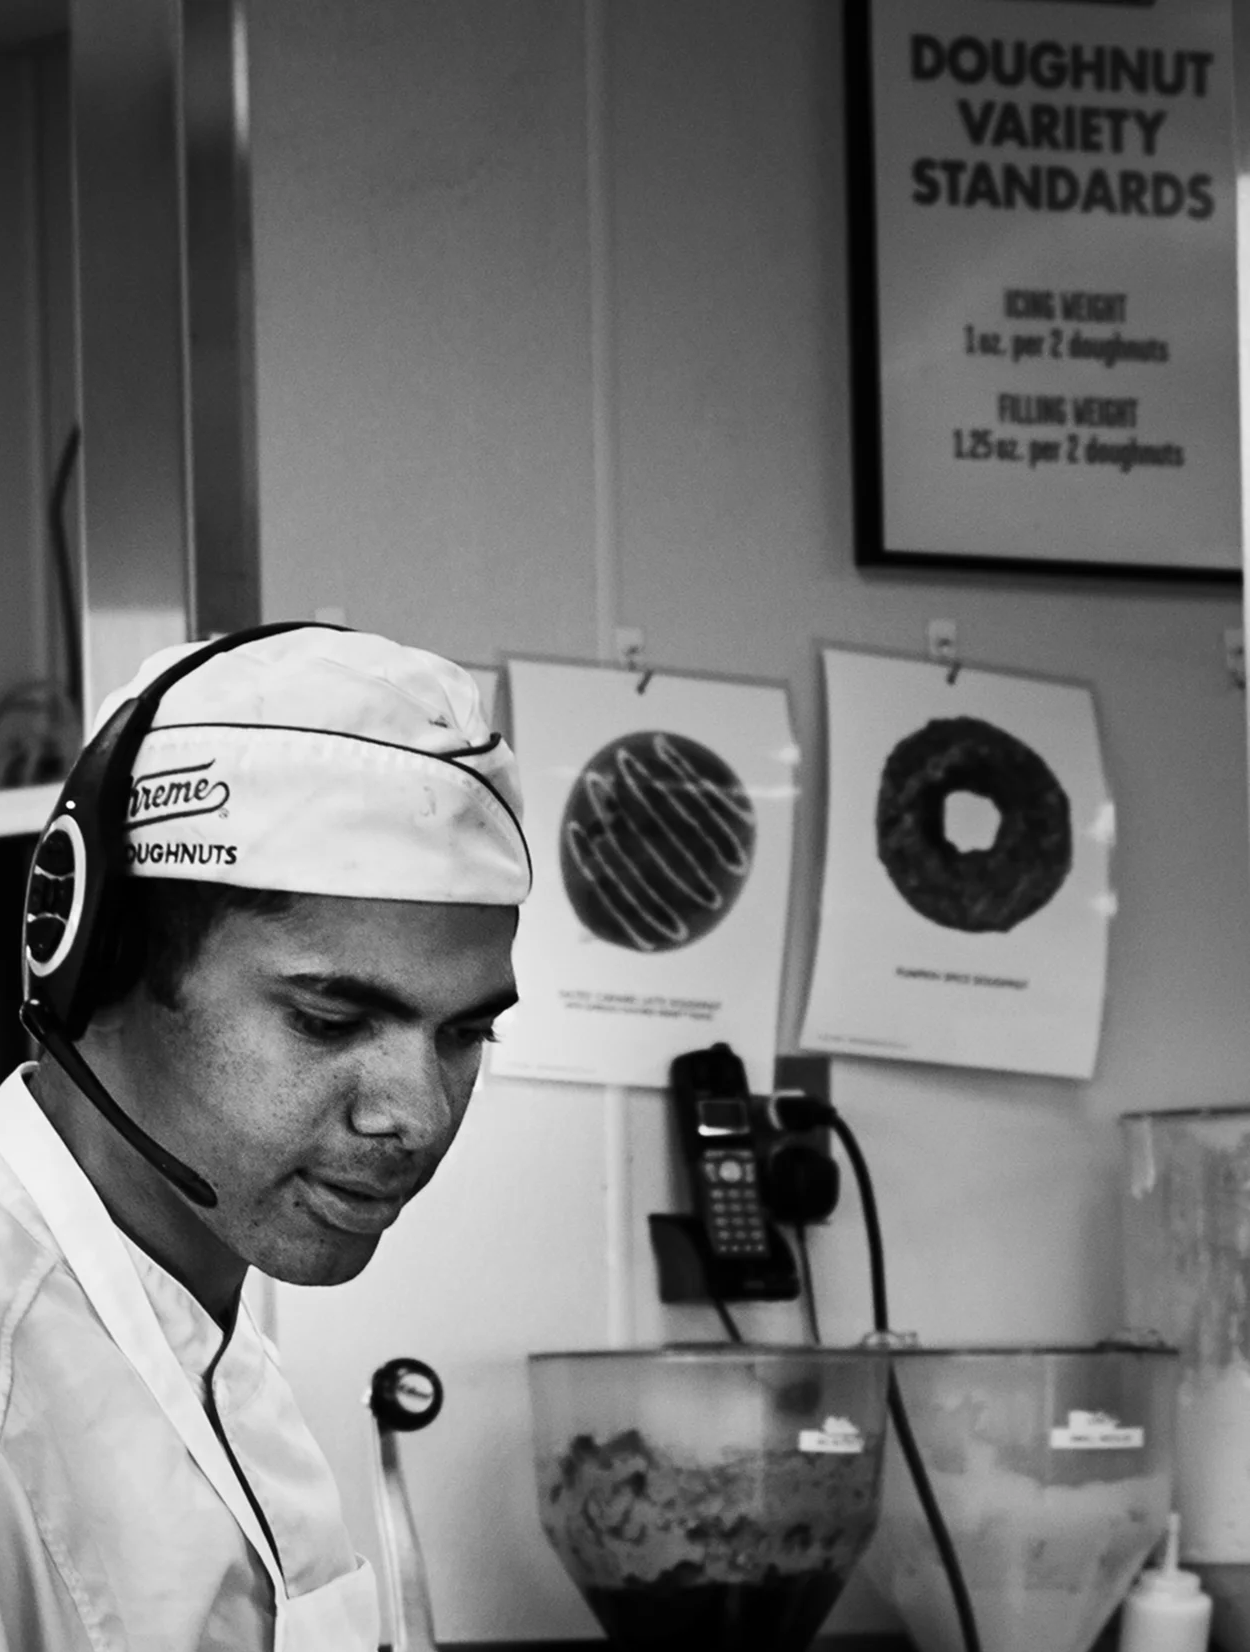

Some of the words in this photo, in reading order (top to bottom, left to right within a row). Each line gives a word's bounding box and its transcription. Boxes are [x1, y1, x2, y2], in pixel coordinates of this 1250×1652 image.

[910, 33, 1215, 97] DOUGHNUT
[957, 98, 1168, 156] VARIETY
[911, 157, 1216, 221] STANDARDS
[1004, 288, 1056, 321] ICING
[1059, 291, 1128, 324] WEIGHT
[963, 323, 976, 356] 1
[1011, 334, 1045, 363] per
[1050, 327, 1064, 359] 2
[1069, 328, 1170, 369] doughnuts
[997, 393, 1068, 426] FILLING
[1072, 396, 1138, 429] WEIGHT
[953, 429, 994, 461] 1.25
[1028, 439, 1061, 469] per
[1066, 432, 1079, 465] 2
[1084, 433, 1186, 474] doughnuts
